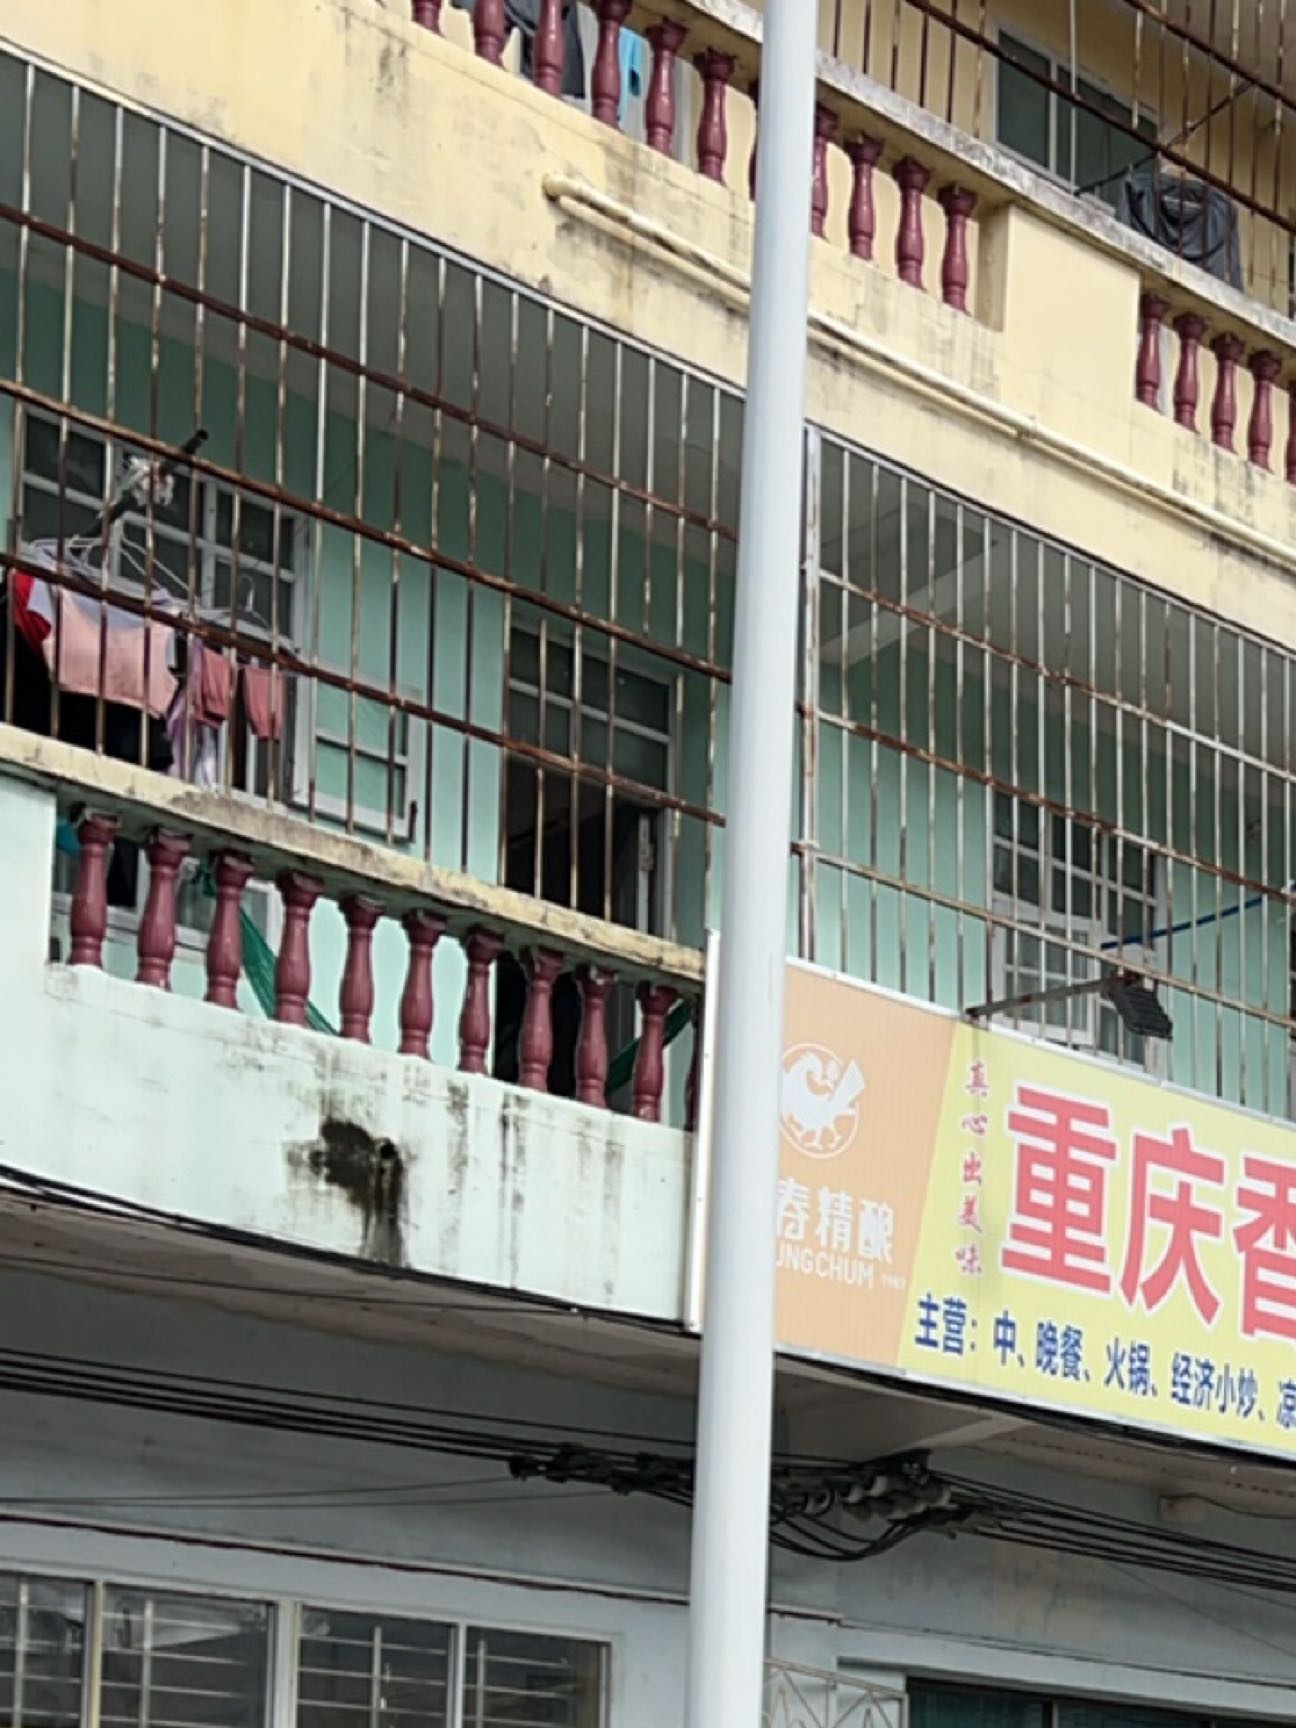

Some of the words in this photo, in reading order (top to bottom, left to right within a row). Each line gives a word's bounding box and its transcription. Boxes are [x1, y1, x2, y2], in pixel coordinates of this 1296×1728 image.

[955, 1060, 989, 1275] 真心出美味
[776, 1177, 893, 1263] 春精酿
[776, 1240, 874, 1289] UNGCHUM
